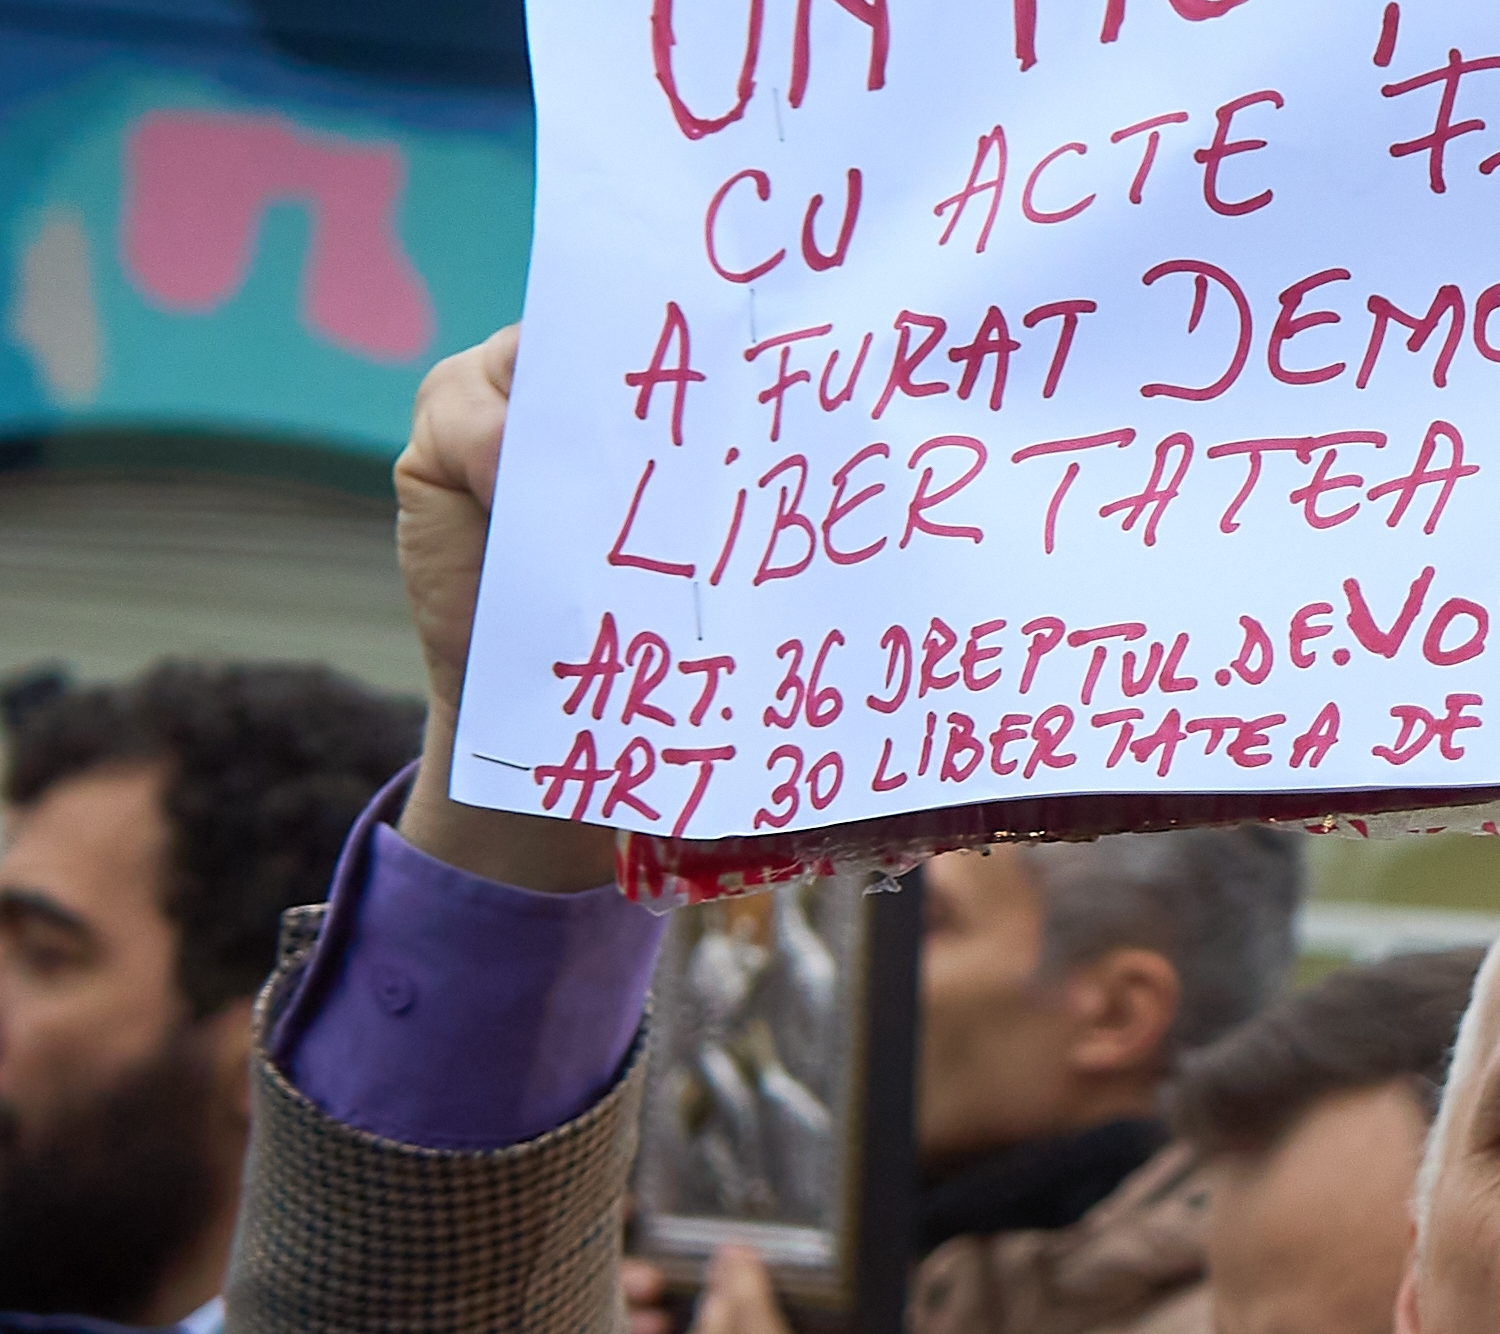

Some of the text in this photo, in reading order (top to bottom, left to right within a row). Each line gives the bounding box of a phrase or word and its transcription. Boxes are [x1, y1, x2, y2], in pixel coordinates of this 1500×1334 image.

[705, 168, 862, 284] CU
[933, 90, 1284, 253] ACTE
[624, 301, 705, 446] A
[744, 300, 1097, 441] FURAT
[552, 613, 736, 727] ART.
[762, 630, 844, 729] 36
[533, 730, 736, 837] ART
[753, 744, 844, 830] 30
[871, 702, 1340, 792] LIBERTATEA
[1371, 693, 1483, 766] DE
